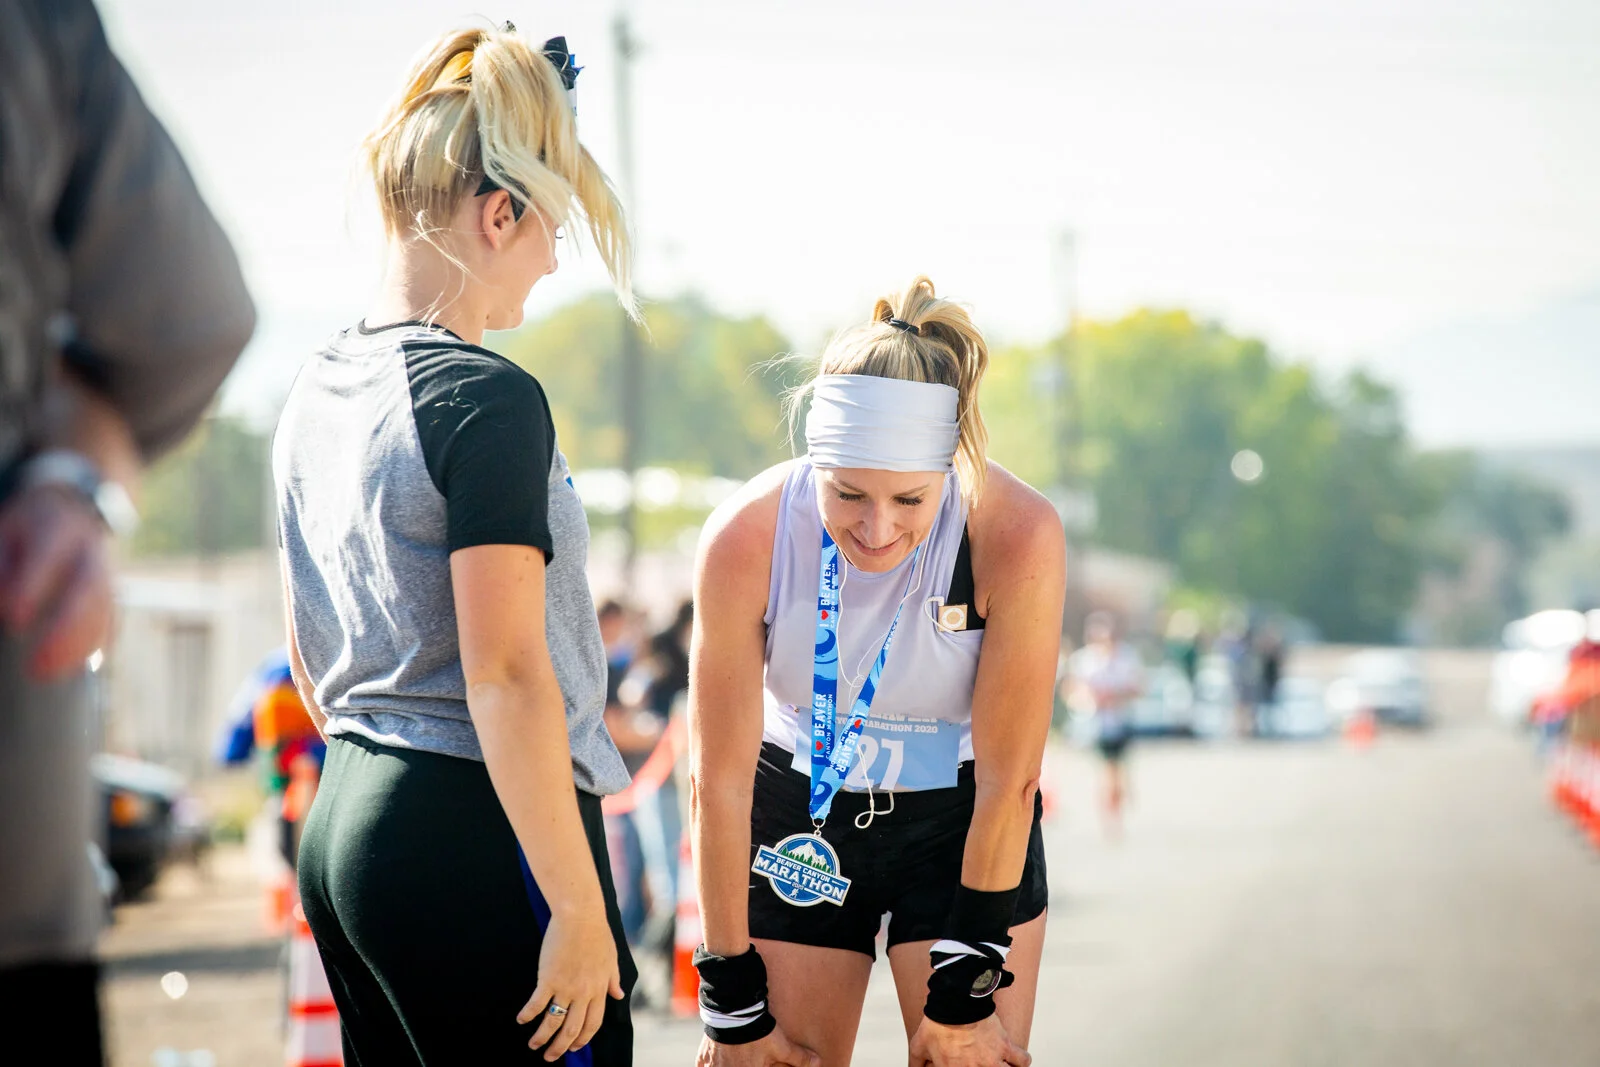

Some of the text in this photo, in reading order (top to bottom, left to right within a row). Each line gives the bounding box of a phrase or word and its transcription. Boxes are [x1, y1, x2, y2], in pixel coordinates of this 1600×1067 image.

[820, 563, 832, 606] BEAVER
[814, 693, 826, 737] BEAVER
[914, 724, 938, 734] 2020
[835, 731, 859, 773] BEAVER
[845, 735, 904, 790] 27
[756, 857, 845, 900] MARATHON
[776, 857, 831, 883] BEAVER CANYON
